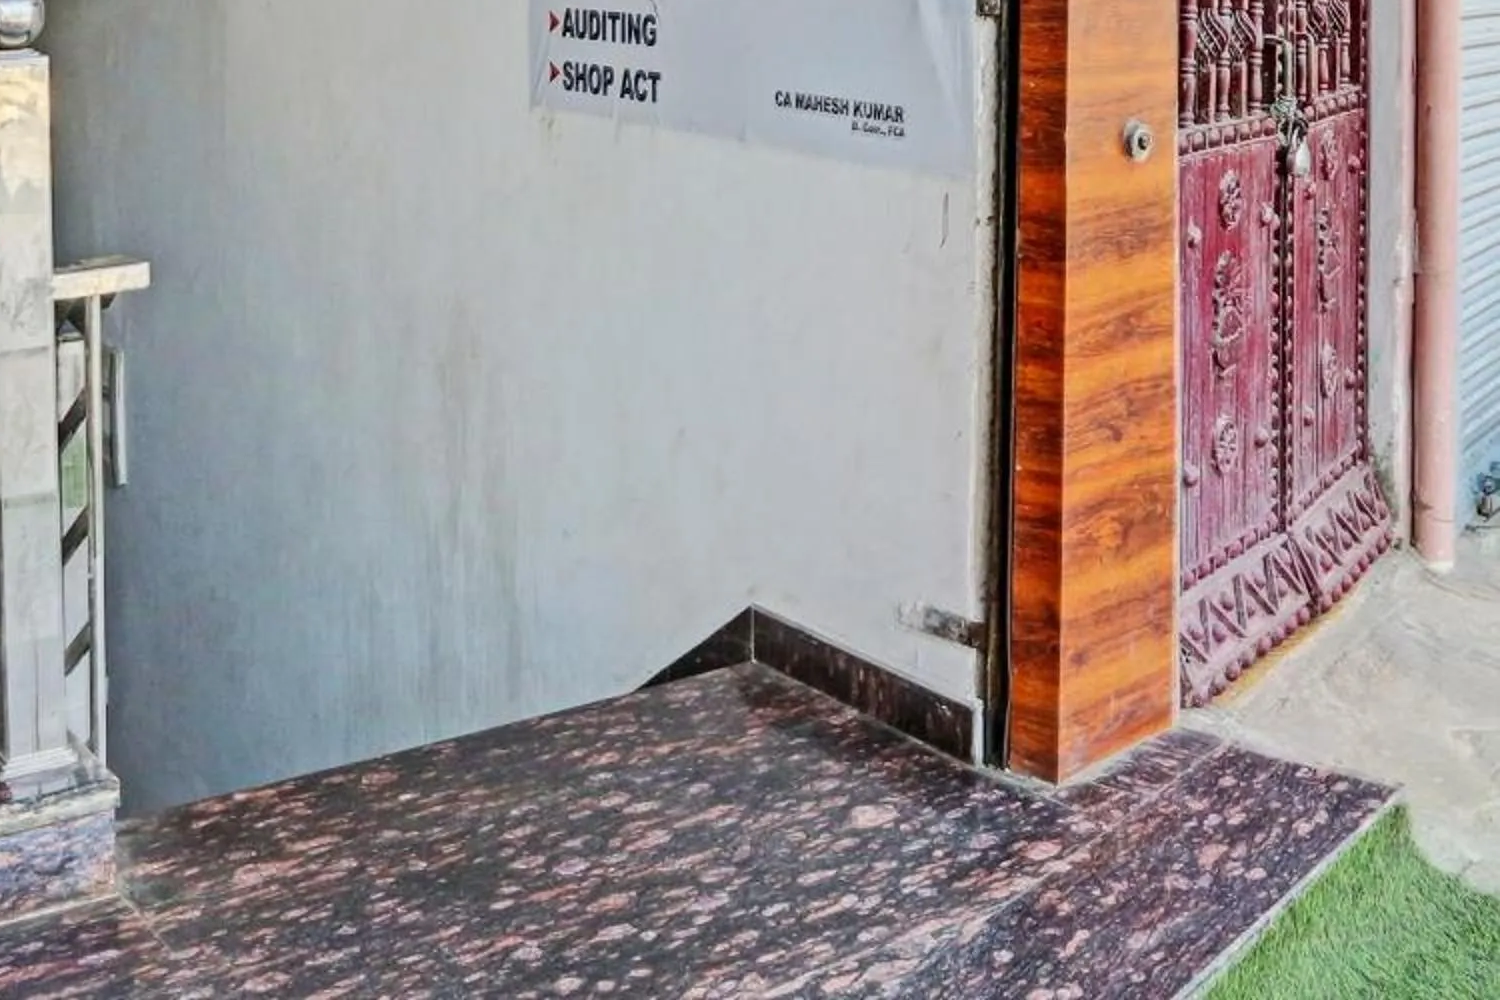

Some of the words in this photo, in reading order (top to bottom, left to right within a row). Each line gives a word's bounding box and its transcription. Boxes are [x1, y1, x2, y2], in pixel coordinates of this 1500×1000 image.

[562, 9, 657, 46] AUDITING
[562, 61, 615, 96] SHOP
[620, 69, 661, 103] ACT
[775, 89, 792, 108] CA
[795, 92, 849, 116] MAHESH
[853, 99, 905, 123] KUMAR
